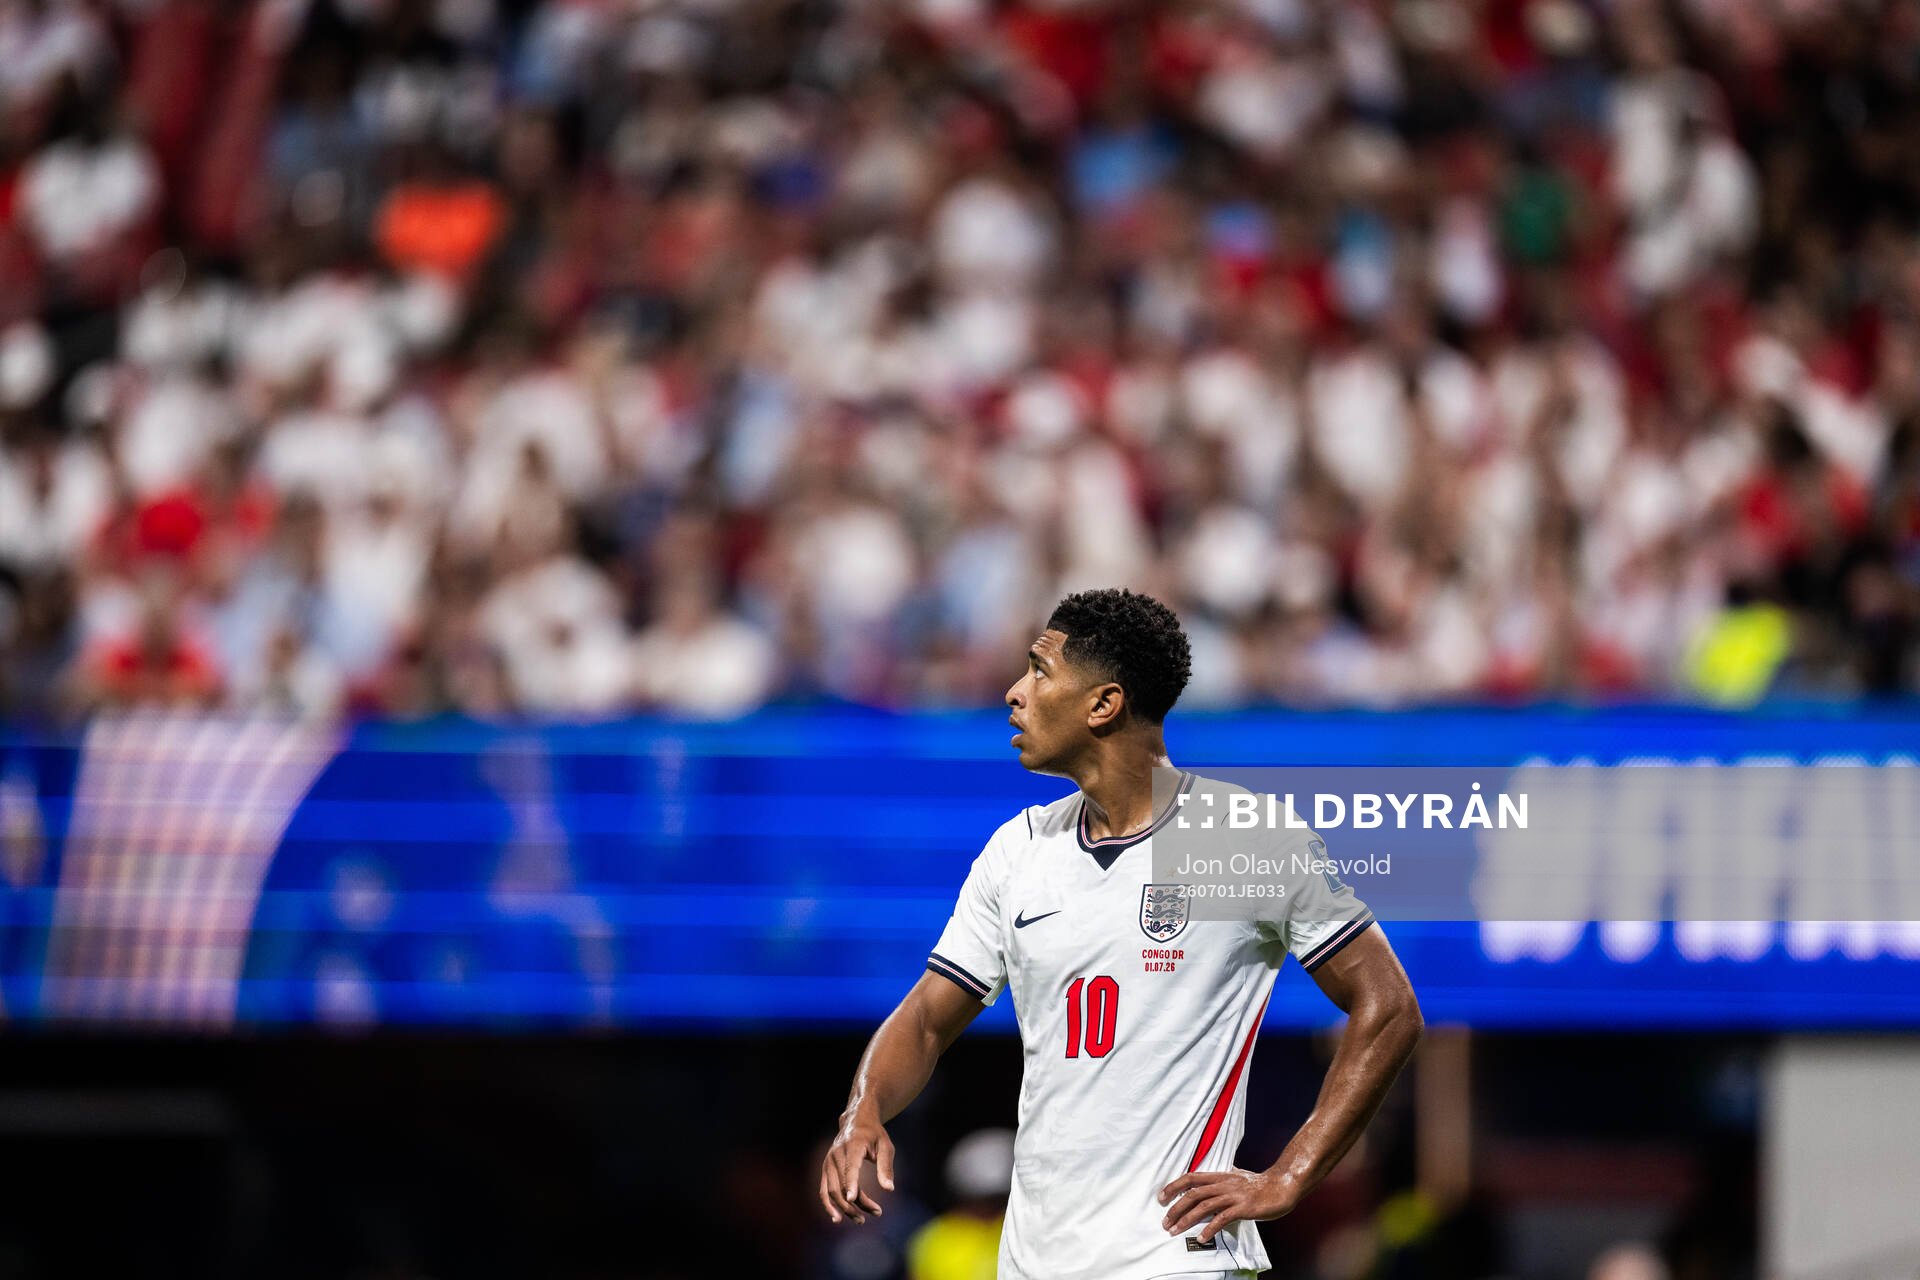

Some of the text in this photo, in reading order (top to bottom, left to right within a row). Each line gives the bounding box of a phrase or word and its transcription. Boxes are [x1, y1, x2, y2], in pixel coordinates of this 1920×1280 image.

[1142, 949, 1185, 960] CONGO DR
[1144, 962, 1175, 972] 01.07.26
[1065, 975, 1119, 1059] 10
